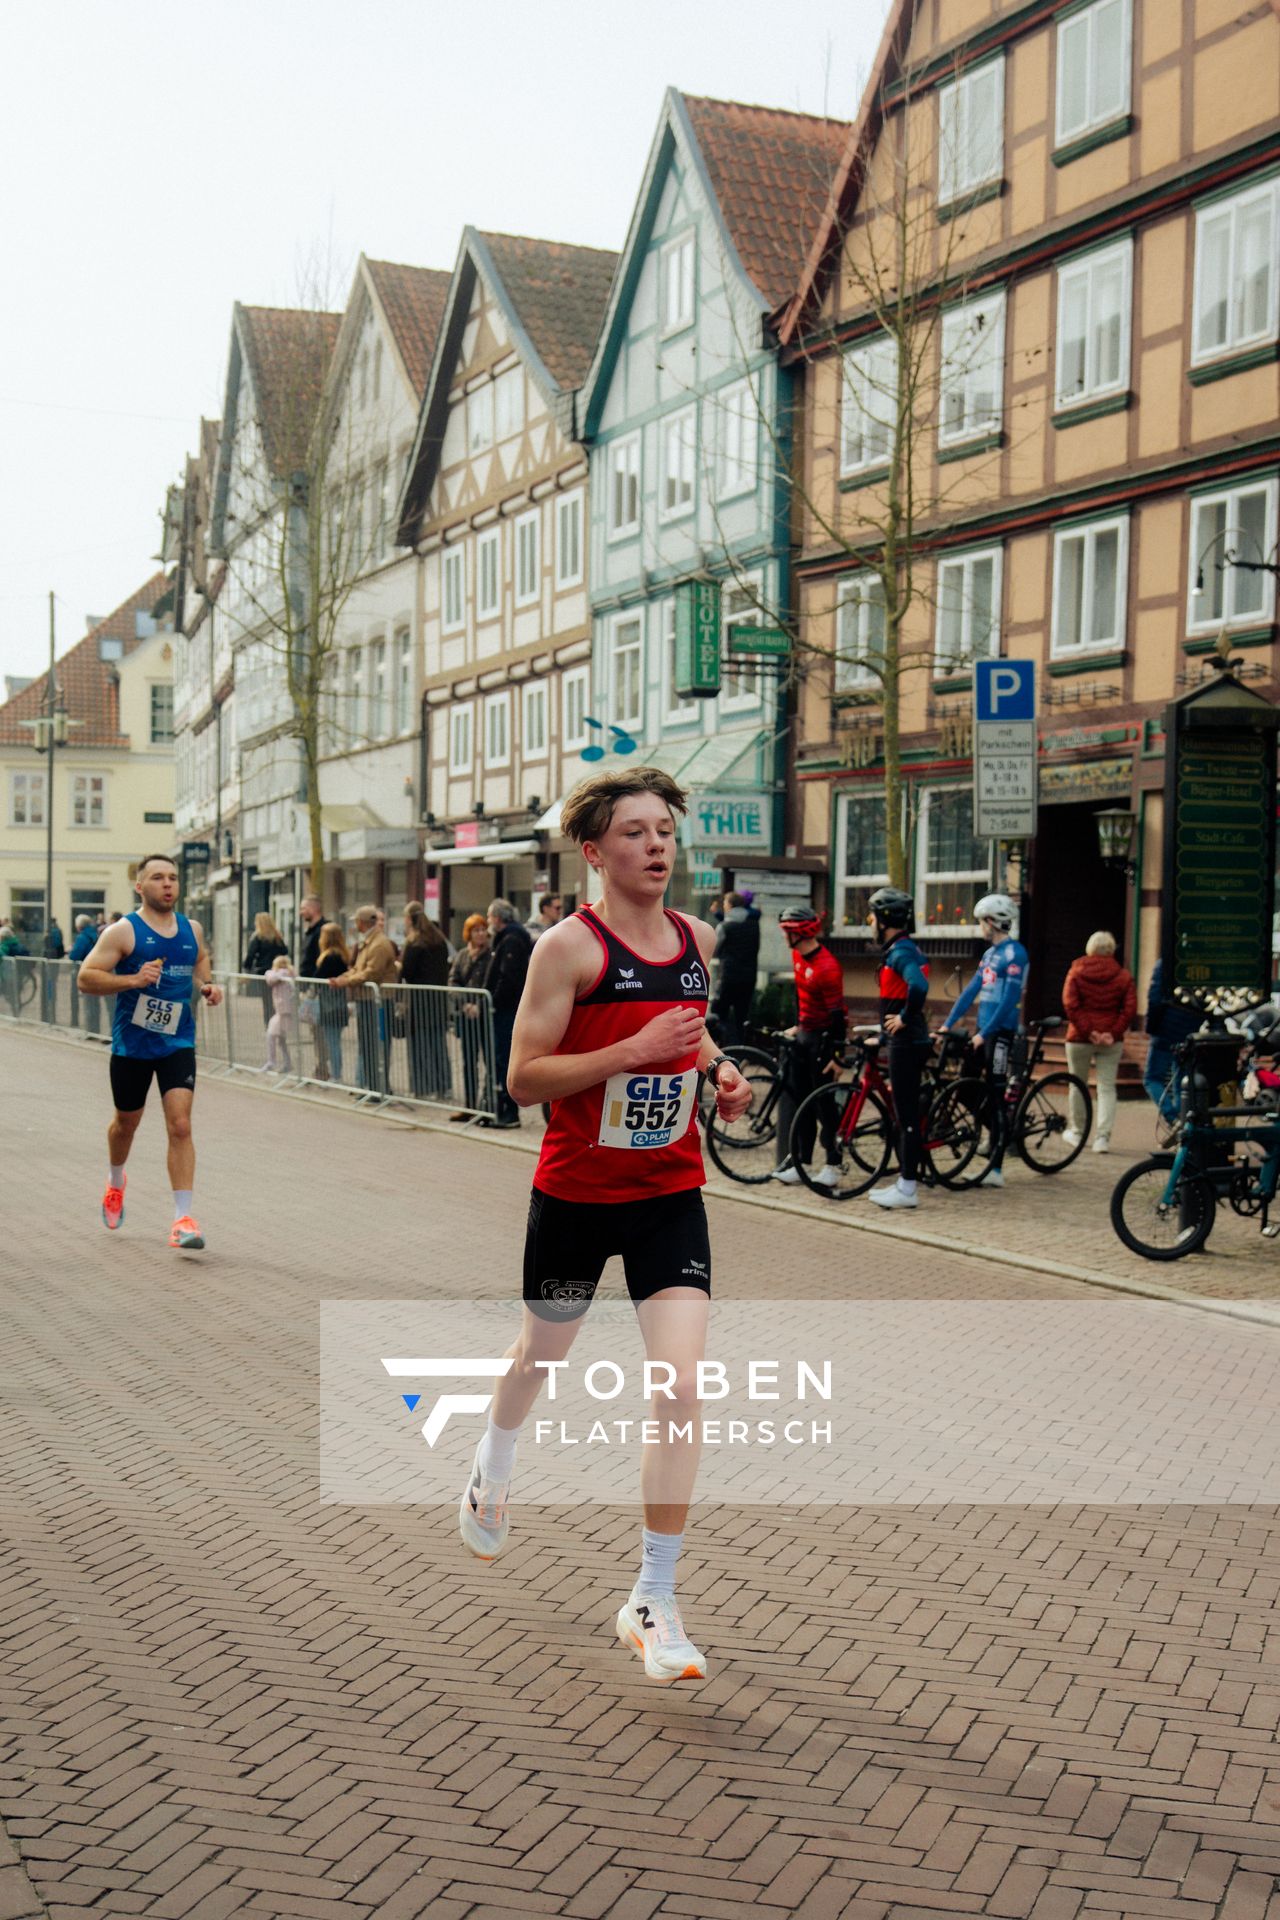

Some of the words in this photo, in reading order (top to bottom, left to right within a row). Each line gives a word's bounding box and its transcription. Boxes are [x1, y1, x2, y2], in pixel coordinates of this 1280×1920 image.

[699, 584, 715, 682] HOTEL
[990, 668, 1021, 714] P
[998, 728, 1013, 737] mit
[698, 813, 761, 834] THIE
[615, 979, 643, 990] erima
[680, 972, 702, 989] OS
[147, 998, 174, 1013] GLS
[145, 1008, 172, 1025] 739
[626, 1076, 683, 1101] GLS
[624, 1099, 681, 1131] 552
[649, 1132, 670, 1141] PLAN
[681, 1267, 708, 1280] erima
